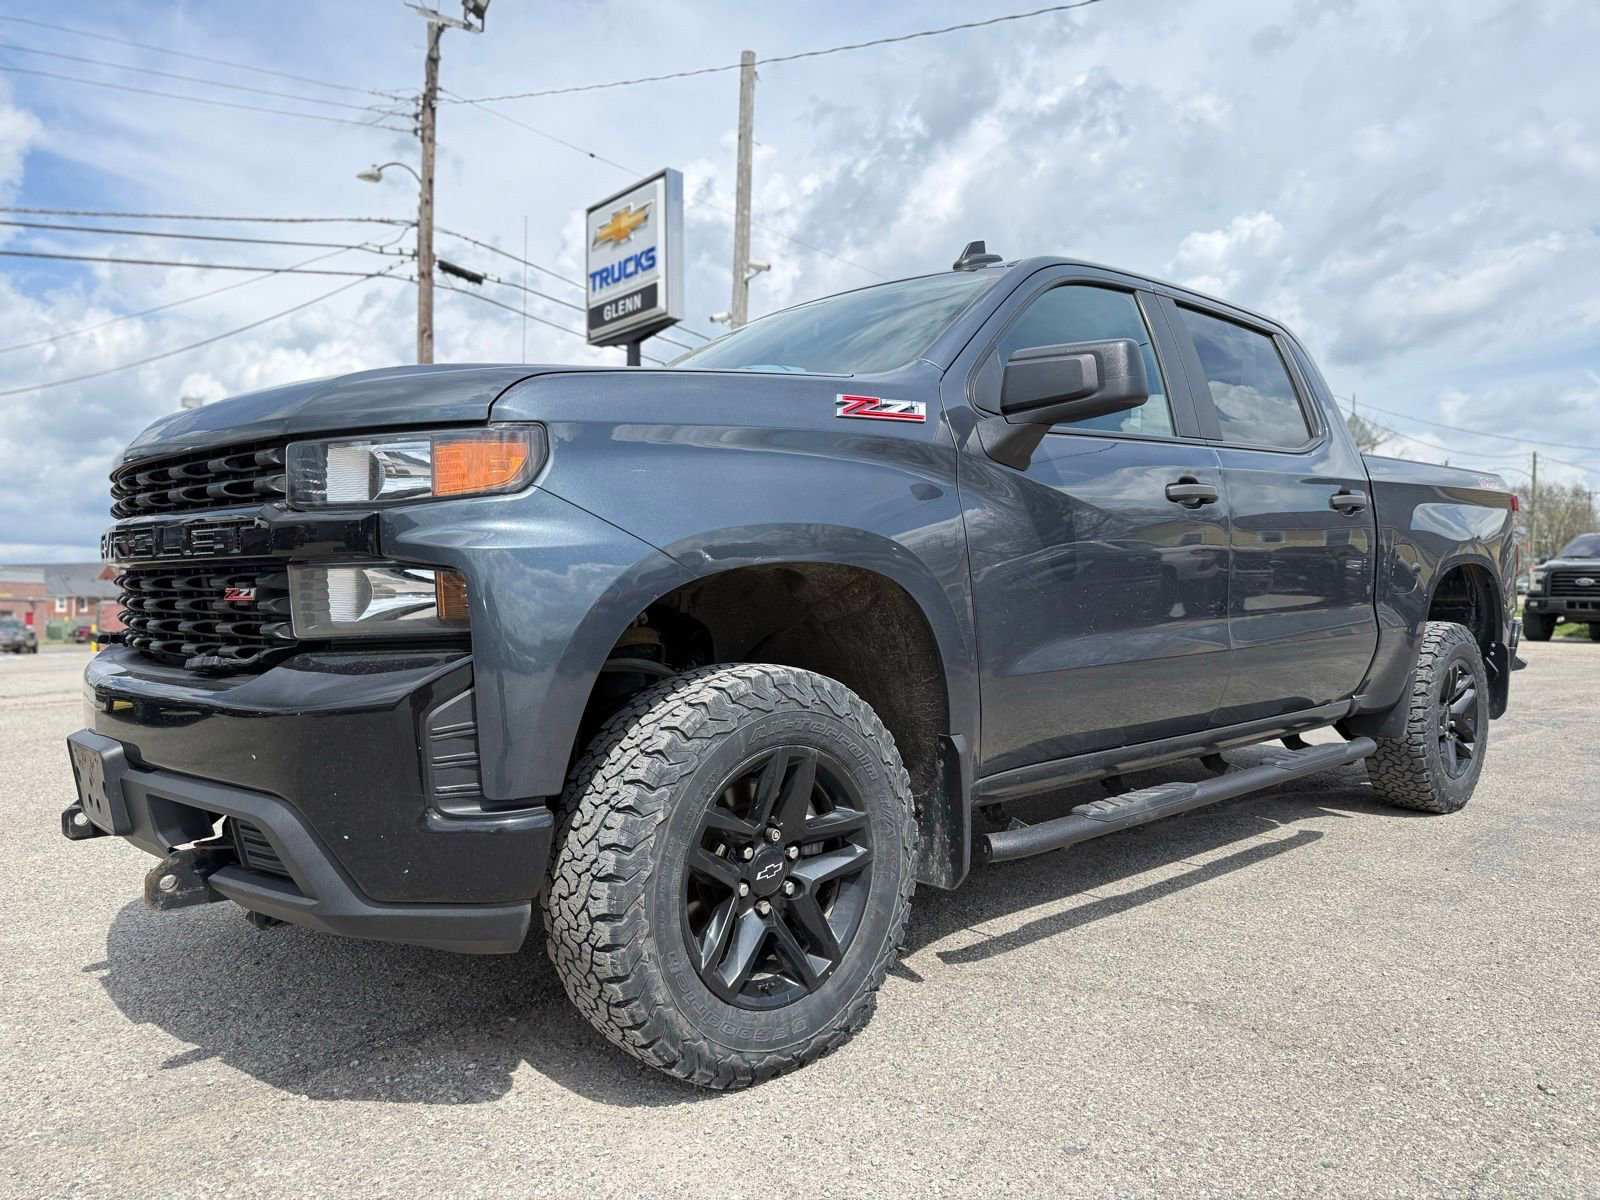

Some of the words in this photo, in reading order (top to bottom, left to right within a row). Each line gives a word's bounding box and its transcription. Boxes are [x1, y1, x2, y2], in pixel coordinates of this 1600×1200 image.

[589, 246, 656, 292] TRUCKS
[603, 293, 642, 321] GLENN
[835, 393, 927, 422] Z71
[223, 587, 256, 601] Z71
